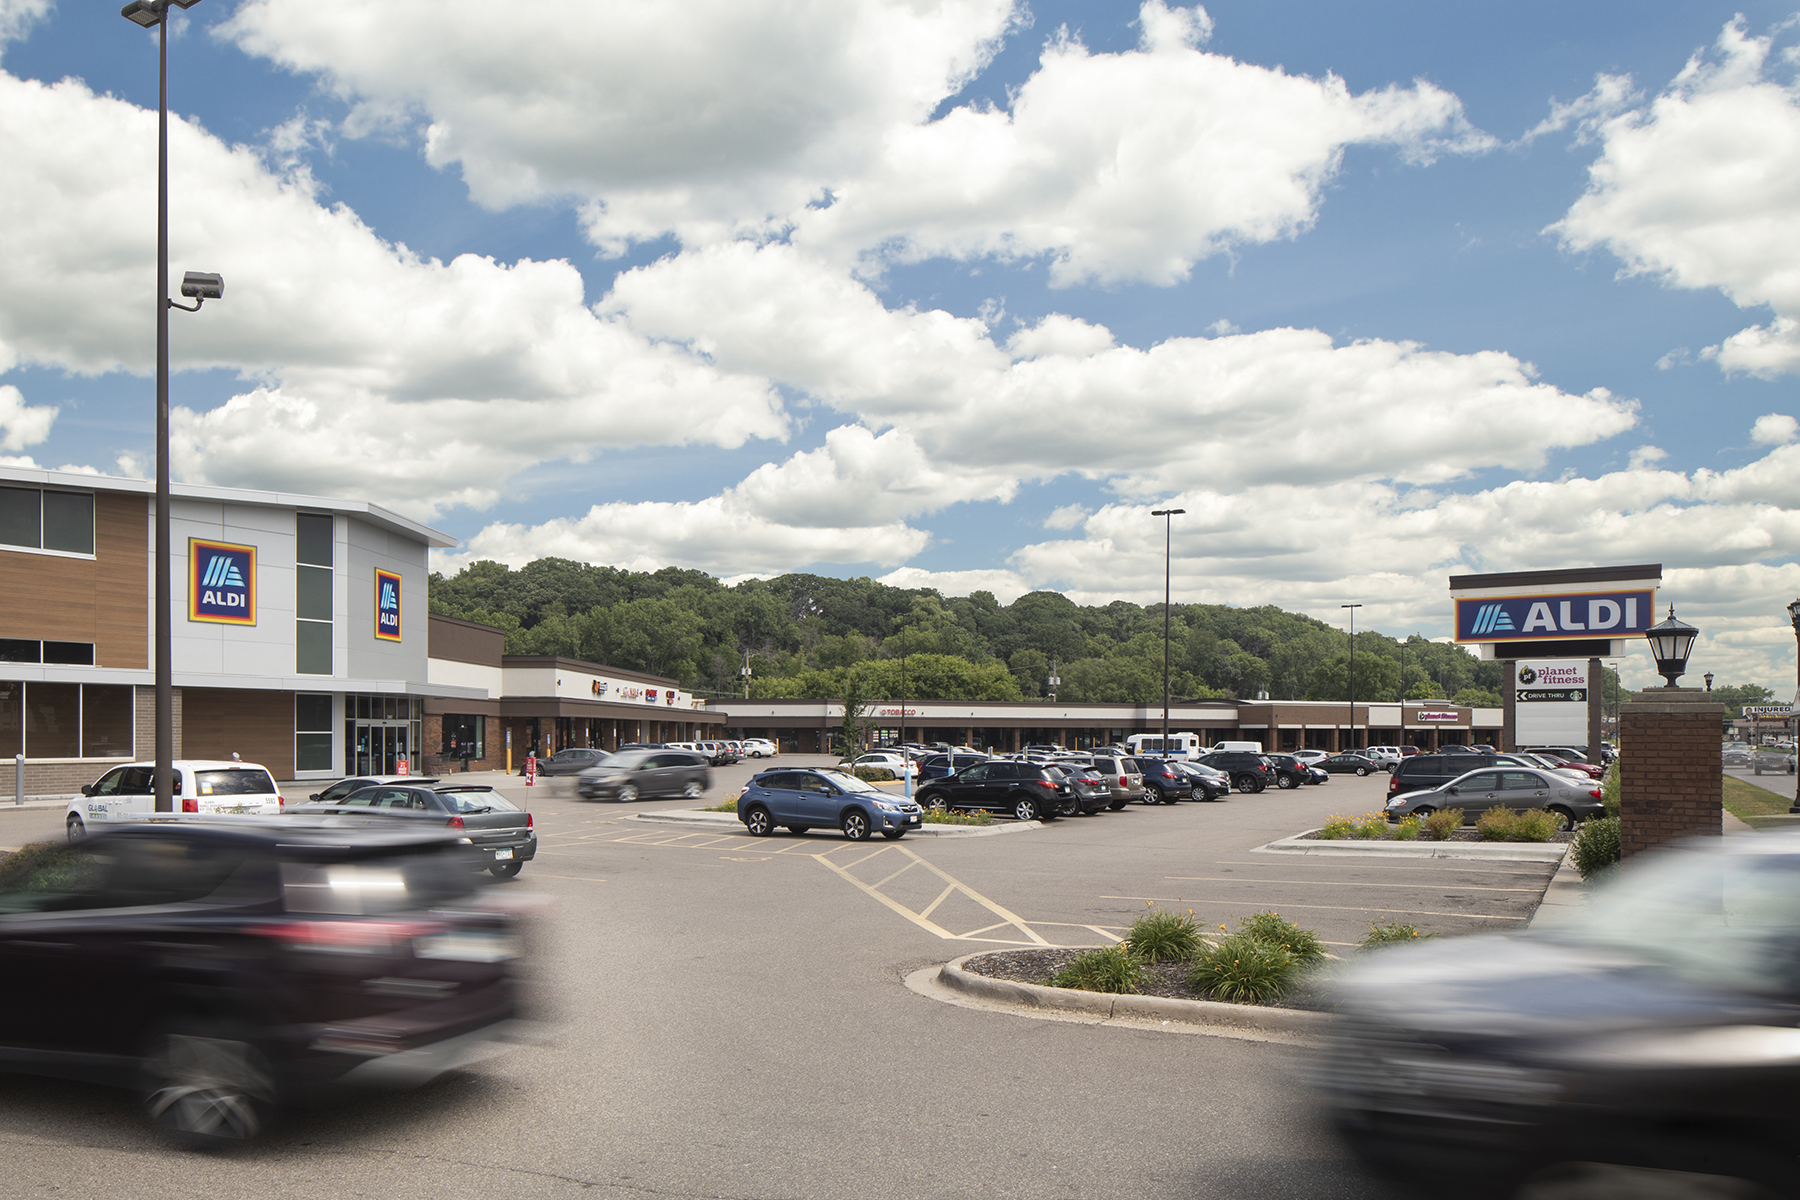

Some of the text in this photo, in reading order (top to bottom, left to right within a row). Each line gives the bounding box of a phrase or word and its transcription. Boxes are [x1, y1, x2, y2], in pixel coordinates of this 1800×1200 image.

[202, 590, 246, 608] ALDI
[380, 612, 398, 627] ALDI
[1521, 597, 1638, 632] ALDI
[1537, 666, 1577, 678] planet
[1542, 675, 1585, 684] fitness
[1754, 706, 1791, 714] INJURED
